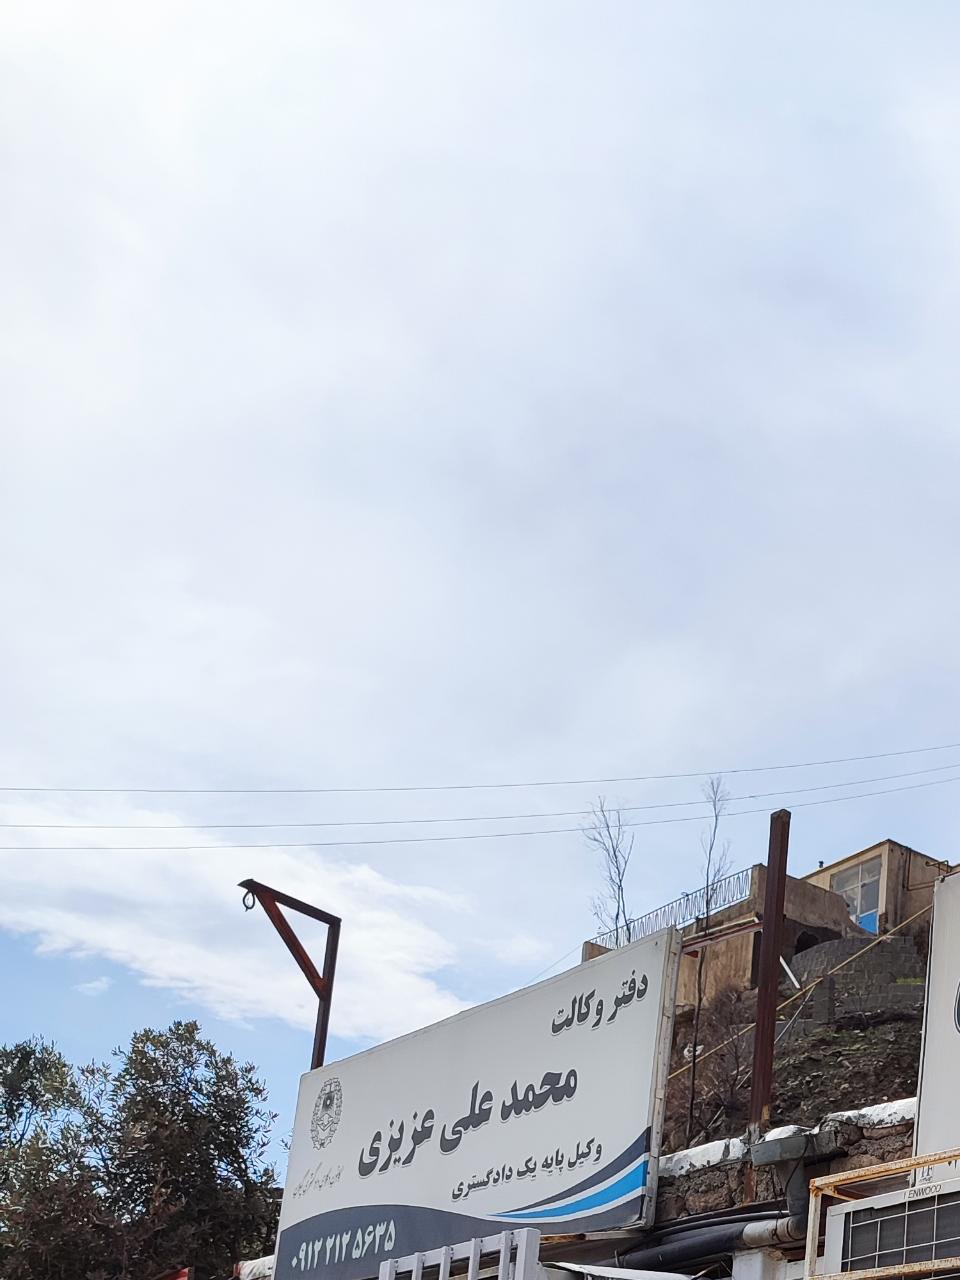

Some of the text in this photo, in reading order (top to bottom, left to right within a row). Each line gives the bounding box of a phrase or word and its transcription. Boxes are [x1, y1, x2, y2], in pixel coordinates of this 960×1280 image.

[551, 970, 649, 1034] دفتر وکالت
[358, 1068, 578, 1177] محمد علی عزیزی
[452, 1137, 603, 1199] وکیل پایه یک دادگستری
[351, 1219, 396, 1259] ۵۶۳۵
